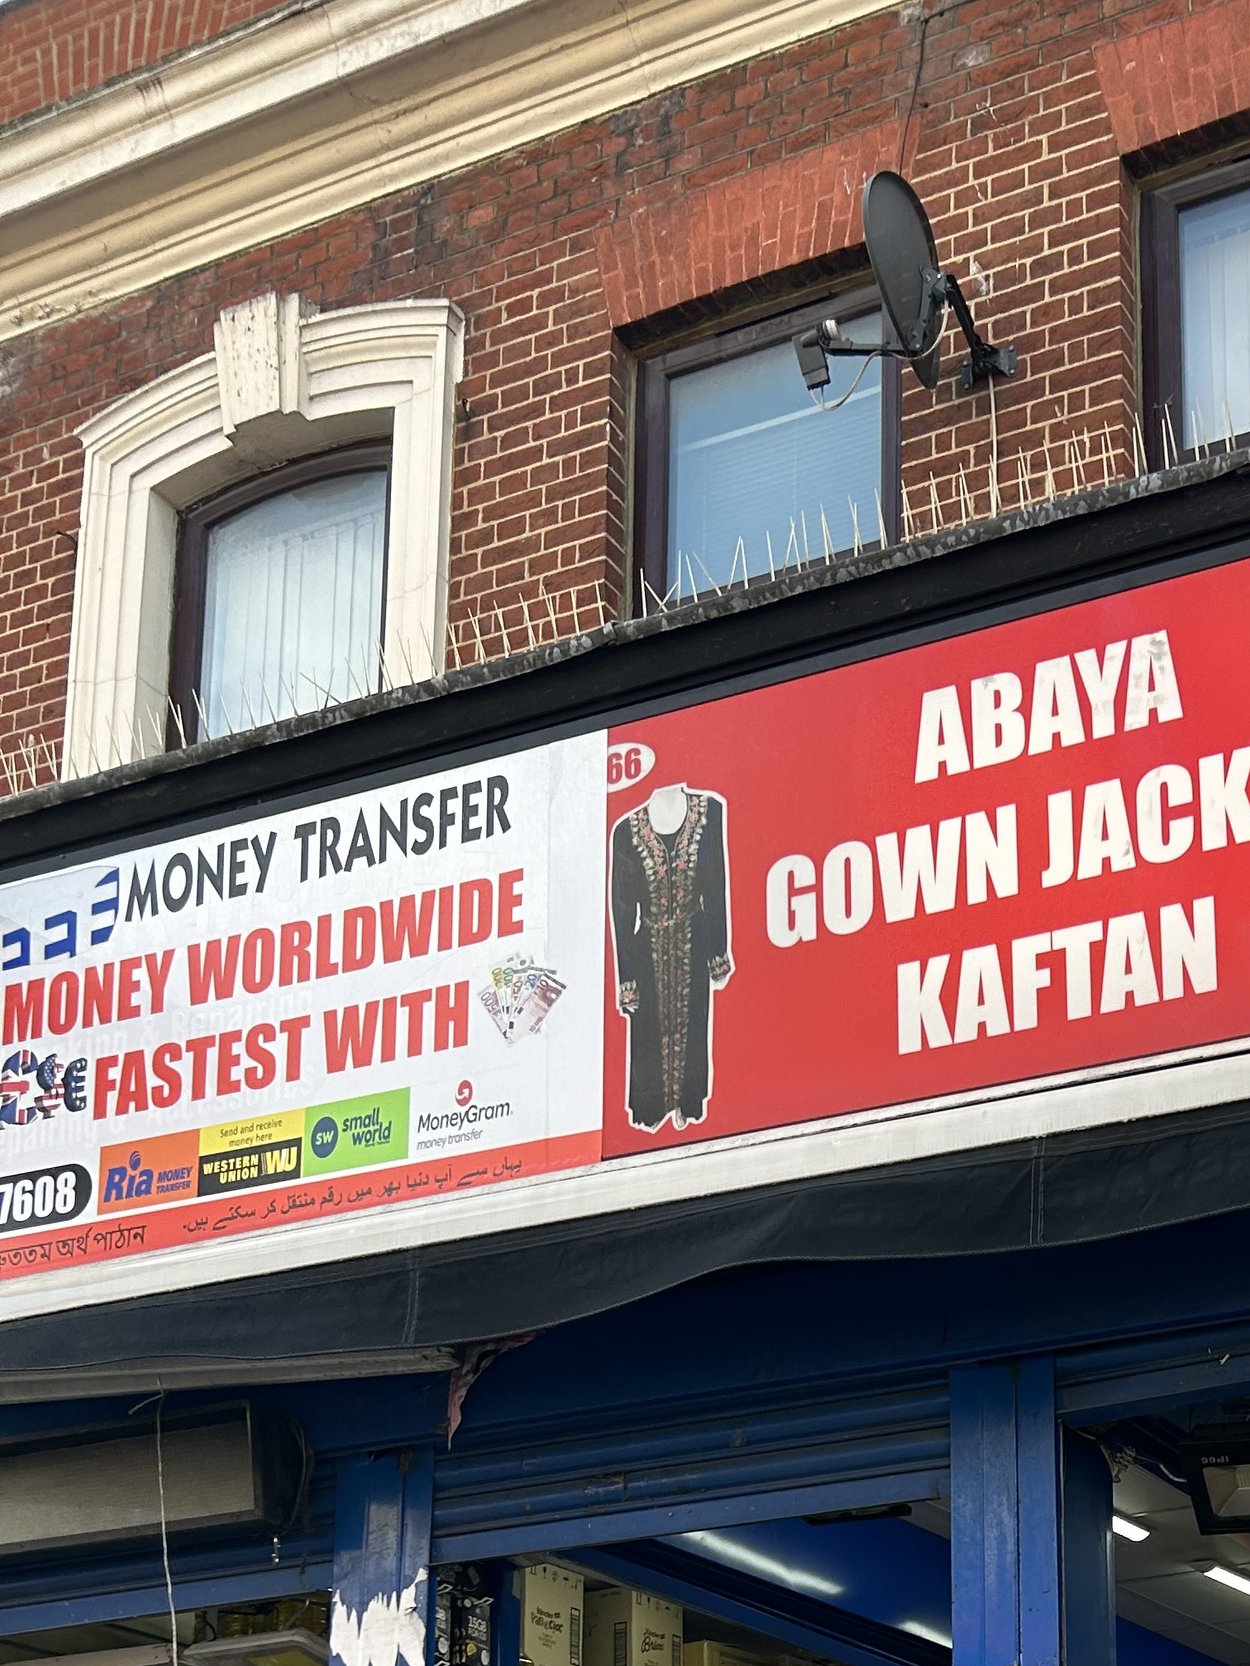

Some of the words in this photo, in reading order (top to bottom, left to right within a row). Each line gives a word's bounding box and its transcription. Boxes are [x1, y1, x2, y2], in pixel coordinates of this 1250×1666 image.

[915, 629, 1184, 784] ABAYA
[124, 831, 277, 922] MONEY
[294, 775, 511, 883] TRANSFER
[765, 803, 1019, 948] GOWN
[2, 948, 176, 1046] MONEY
[187, 868, 524, 1006] WORLDWIDE
[896, 895, 1217, 1055] KAFTAN
[93, 1014, 311, 1121] FASTEST
[323, 980, 470, 1075] WITH
[219, 1122, 238, 1138] Send
[240, 1121, 255, 1134] and
[256, 1118, 283, 1132] receive
[342, 1106, 380, 1132] small
[417, 1101, 511, 1133] MoneyGram
[228, 1135, 254, 1147] money
[255, 1132, 273, 1143] here
[352, 1120, 392, 1147] world
[417, 1136, 447, 1150] money
[448, 1128, 483, 1144] transfer
[103, 1151, 153, 1203] Ria
[156, 1166, 193, 1184] MONEY
[203, 1153, 259, 1175] WESTERN
[218, 1166, 258, 1184] UNION
[434, 1163, 452, 1189] آپ
[156, 1180, 192, 1195] TRANSFER
